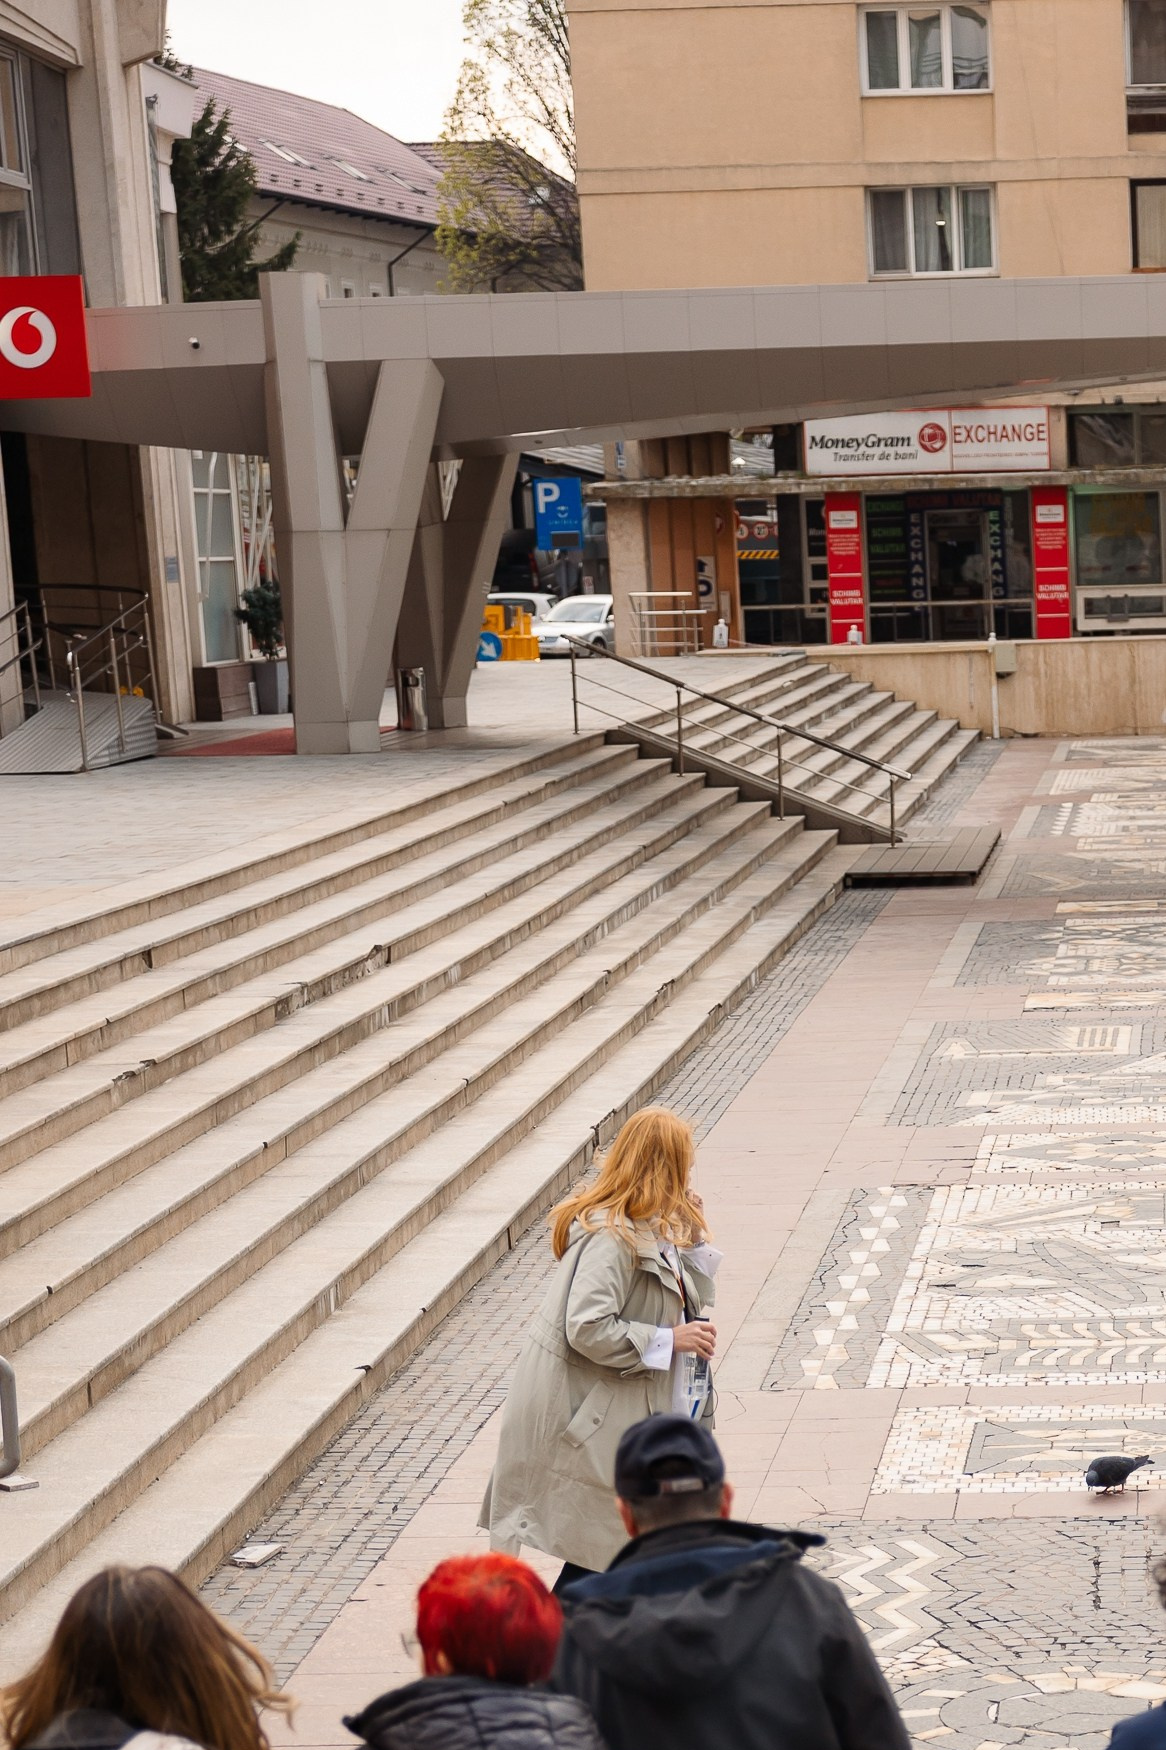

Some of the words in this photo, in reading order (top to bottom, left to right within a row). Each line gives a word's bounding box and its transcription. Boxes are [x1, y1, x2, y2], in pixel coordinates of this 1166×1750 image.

[953, 423, 1046, 443] EXCHANGE
[809, 434, 911, 451] MoneyGram
[833, 450, 875, 462] Transfer
[878, 450, 891, 461] de
[894, 449, 918, 461] bani
[537, 482, 560, 513] P
